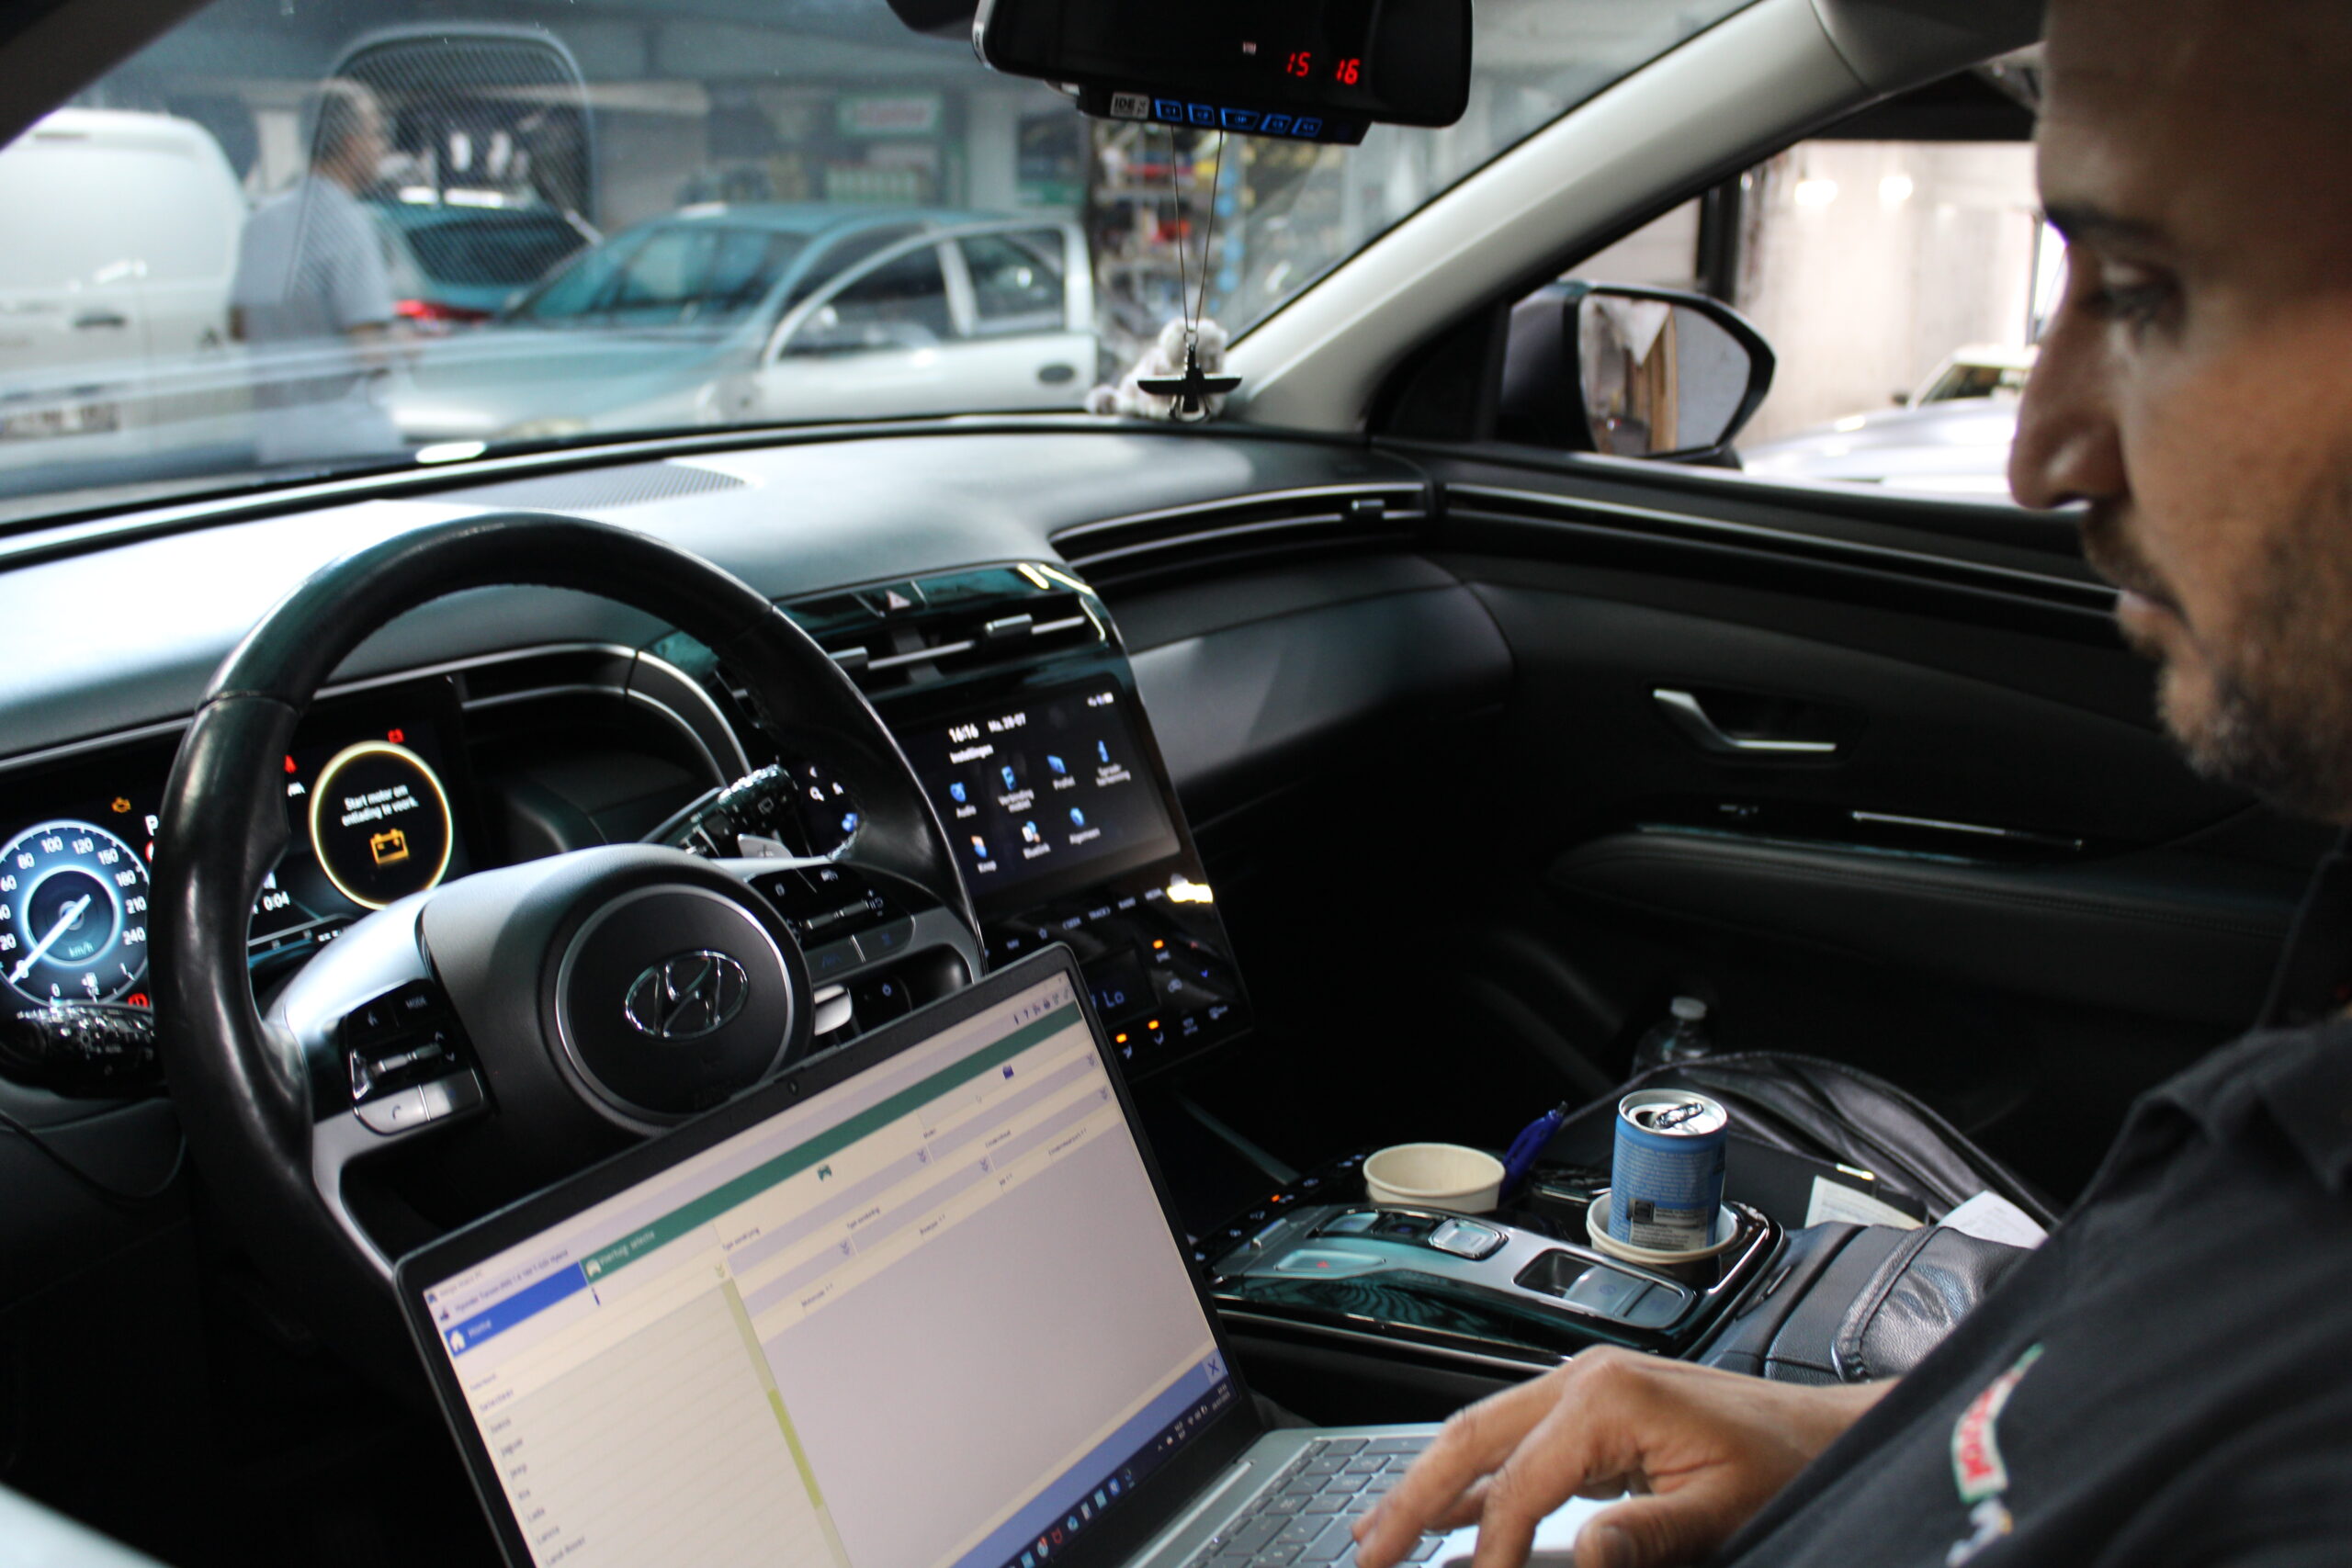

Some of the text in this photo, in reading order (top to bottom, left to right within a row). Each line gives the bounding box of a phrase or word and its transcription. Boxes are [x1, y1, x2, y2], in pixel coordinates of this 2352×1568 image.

[1287, 51, 1360, 85] 15 16
[948, 723, 979, 743] 16:16
[344, 794, 368, 811] Start
[368, 787, 392, 806] motor
[145, 815, 159, 837] P
[40, 836, 63, 853] 100
[72, 837, 95, 855] 120
[17, 852, 35, 869] 80
[97, 848, 119, 865] 150
[0, 874, 17, 892] 60
[115, 870, 137, 887] 180
[125, 896, 147, 914] 210
[263, 891, 290, 911] 0:04
[0, 933, 17, 951] 20
[122, 927, 146, 946] 240
[68, 942, 95, 958] km/h
[51, 983, 61, 997] 0
[1102, 990, 1125, 1008] Lo
[405, 995, 427, 1010] MODE
[467, 1319, 492, 1339] Home
